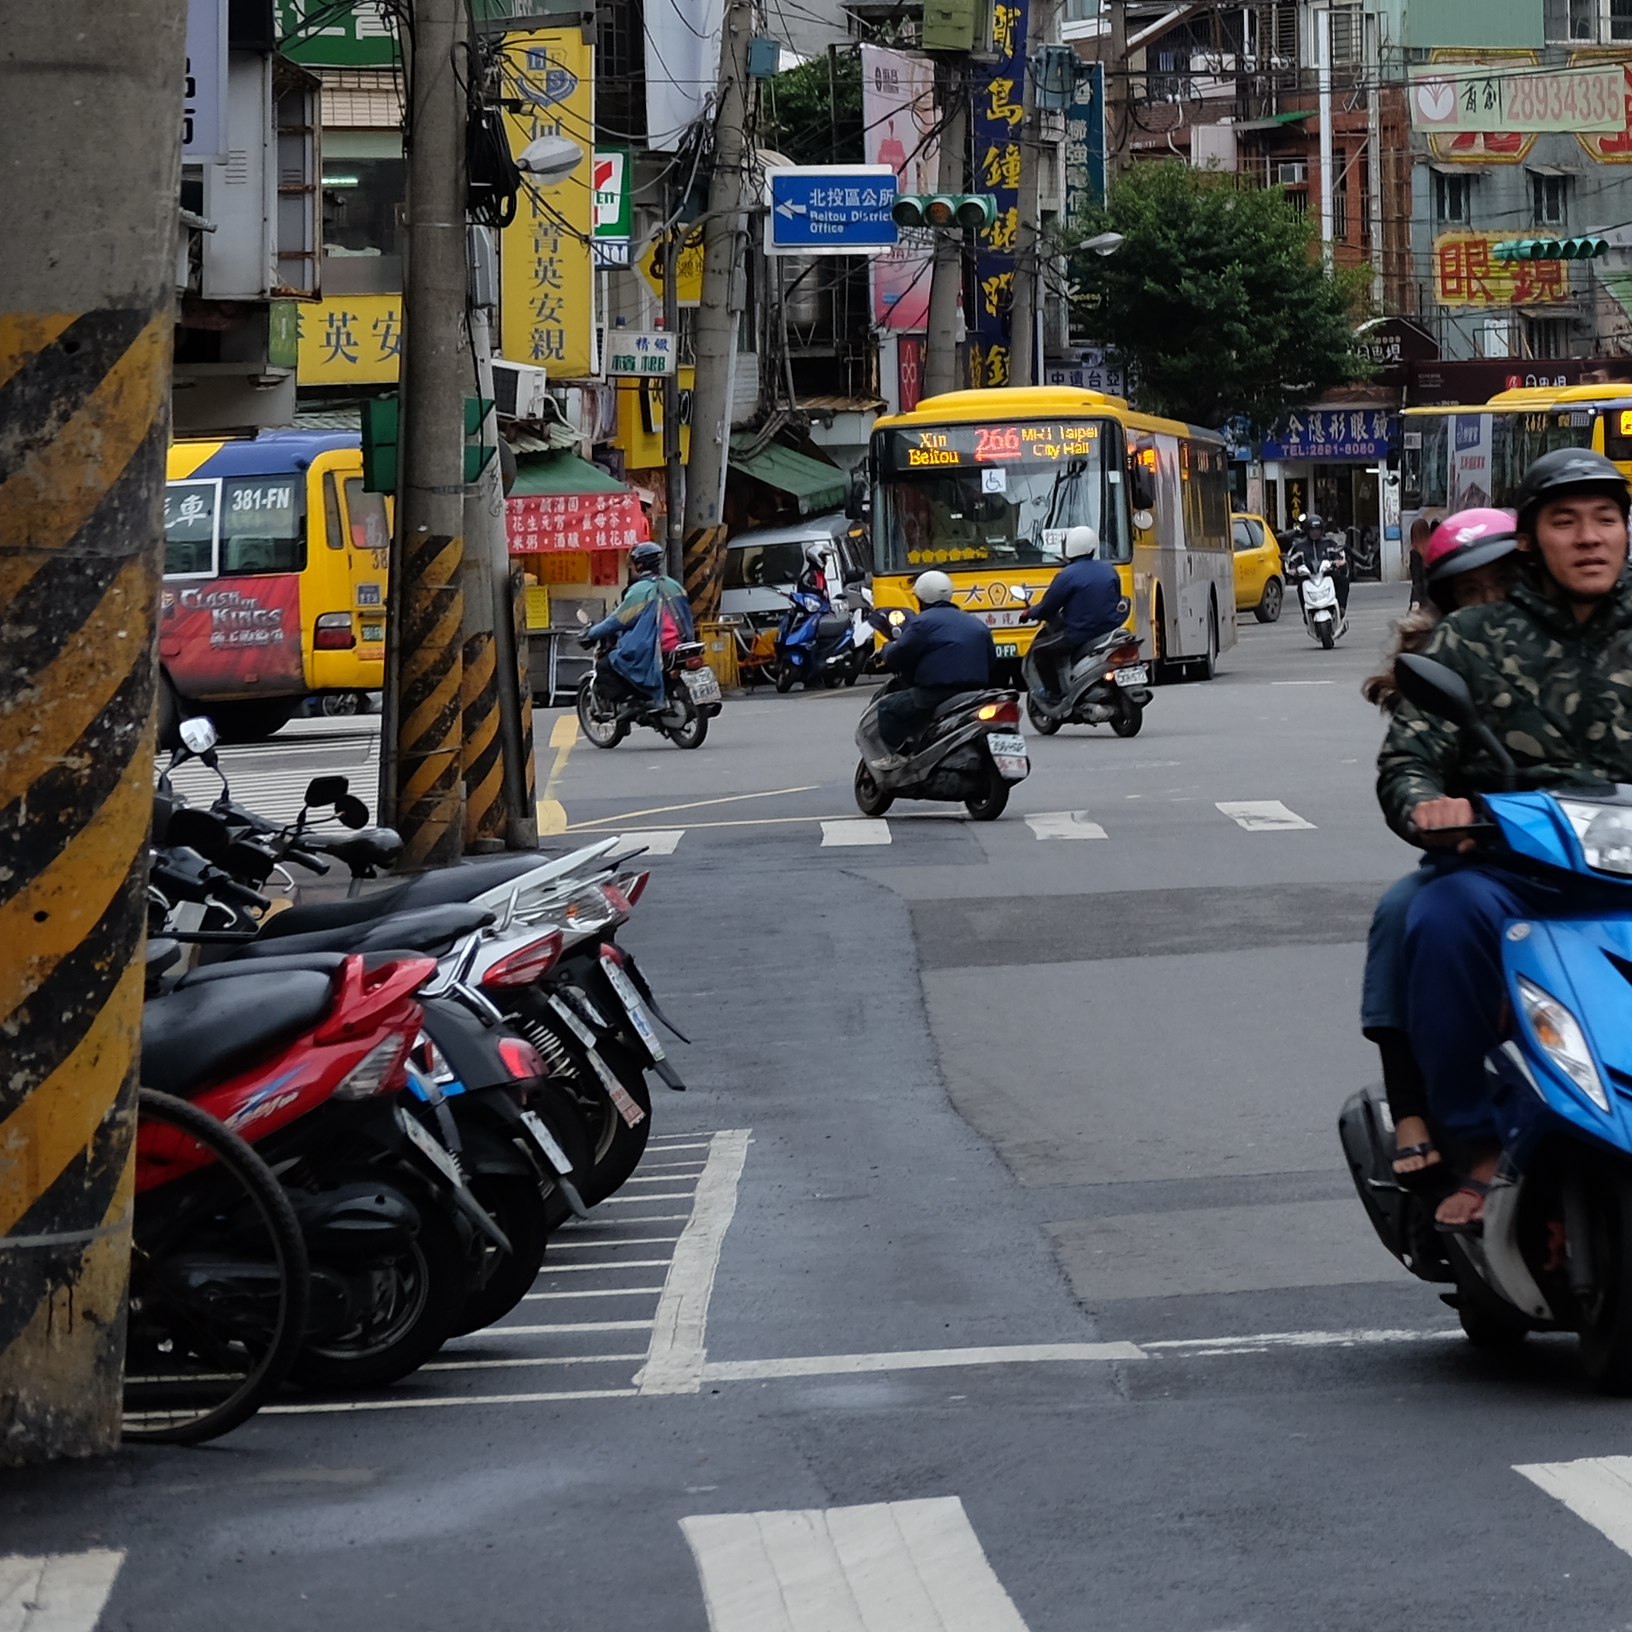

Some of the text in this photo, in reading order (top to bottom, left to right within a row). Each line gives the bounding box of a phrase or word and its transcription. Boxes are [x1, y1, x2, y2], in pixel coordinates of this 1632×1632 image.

[1506, 75, 1620, 122] 28934335
[809, 188, 893, 207] 北投區公所
[809, 223, 844, 234] Office
[1439, 237, 1569, 304] 眼鏡
[920, 433, 947, 448] Xin
[974, 428, 1020, 450] 266
[1063, 441, 1090, 455] Hall
[231, 486, 291, 511] 381-FN
[211, 608, 283, 626] KINGS
